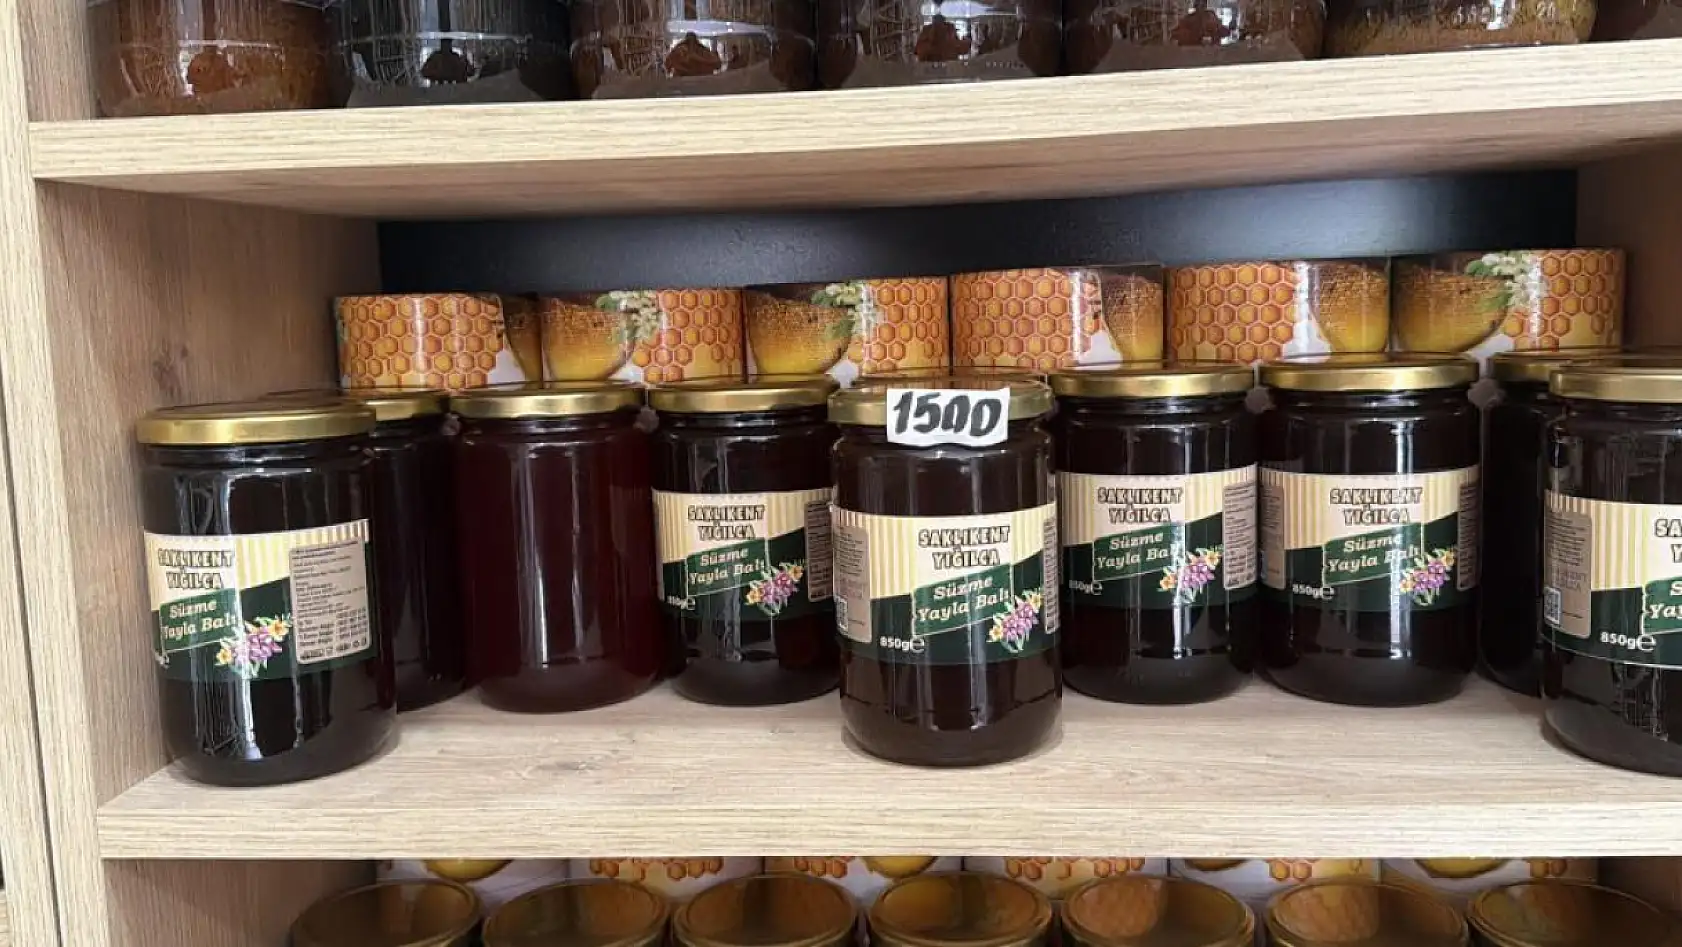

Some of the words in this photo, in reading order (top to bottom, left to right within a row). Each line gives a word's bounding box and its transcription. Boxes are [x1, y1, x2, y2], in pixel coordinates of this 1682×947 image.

[893, 391, 1002, 437] 1500
[1097, 487, 1183, 504] SAKLIKENT
[1330, 486, 1423, 505] SAKLIKENT
[688, 504, 766, 521] SAKLIKENT
[918, 525, 1010, 548] SAKLIKENT
[1110, 532, 1164, 550] Süzme
[1343, 533, 1404, 553] Süzme
[701, 548, 749, 567] Süzme
[1097, 551, 1140, 569] Yayla
[1328, 553, 1378, 574] Yayla
[689, 567, 729, 585] Yayla
[933, 576, 994, 601] Süzme
[916, 601, 970, 622] Yayla
[976, 588, 1009, 609] Balı
